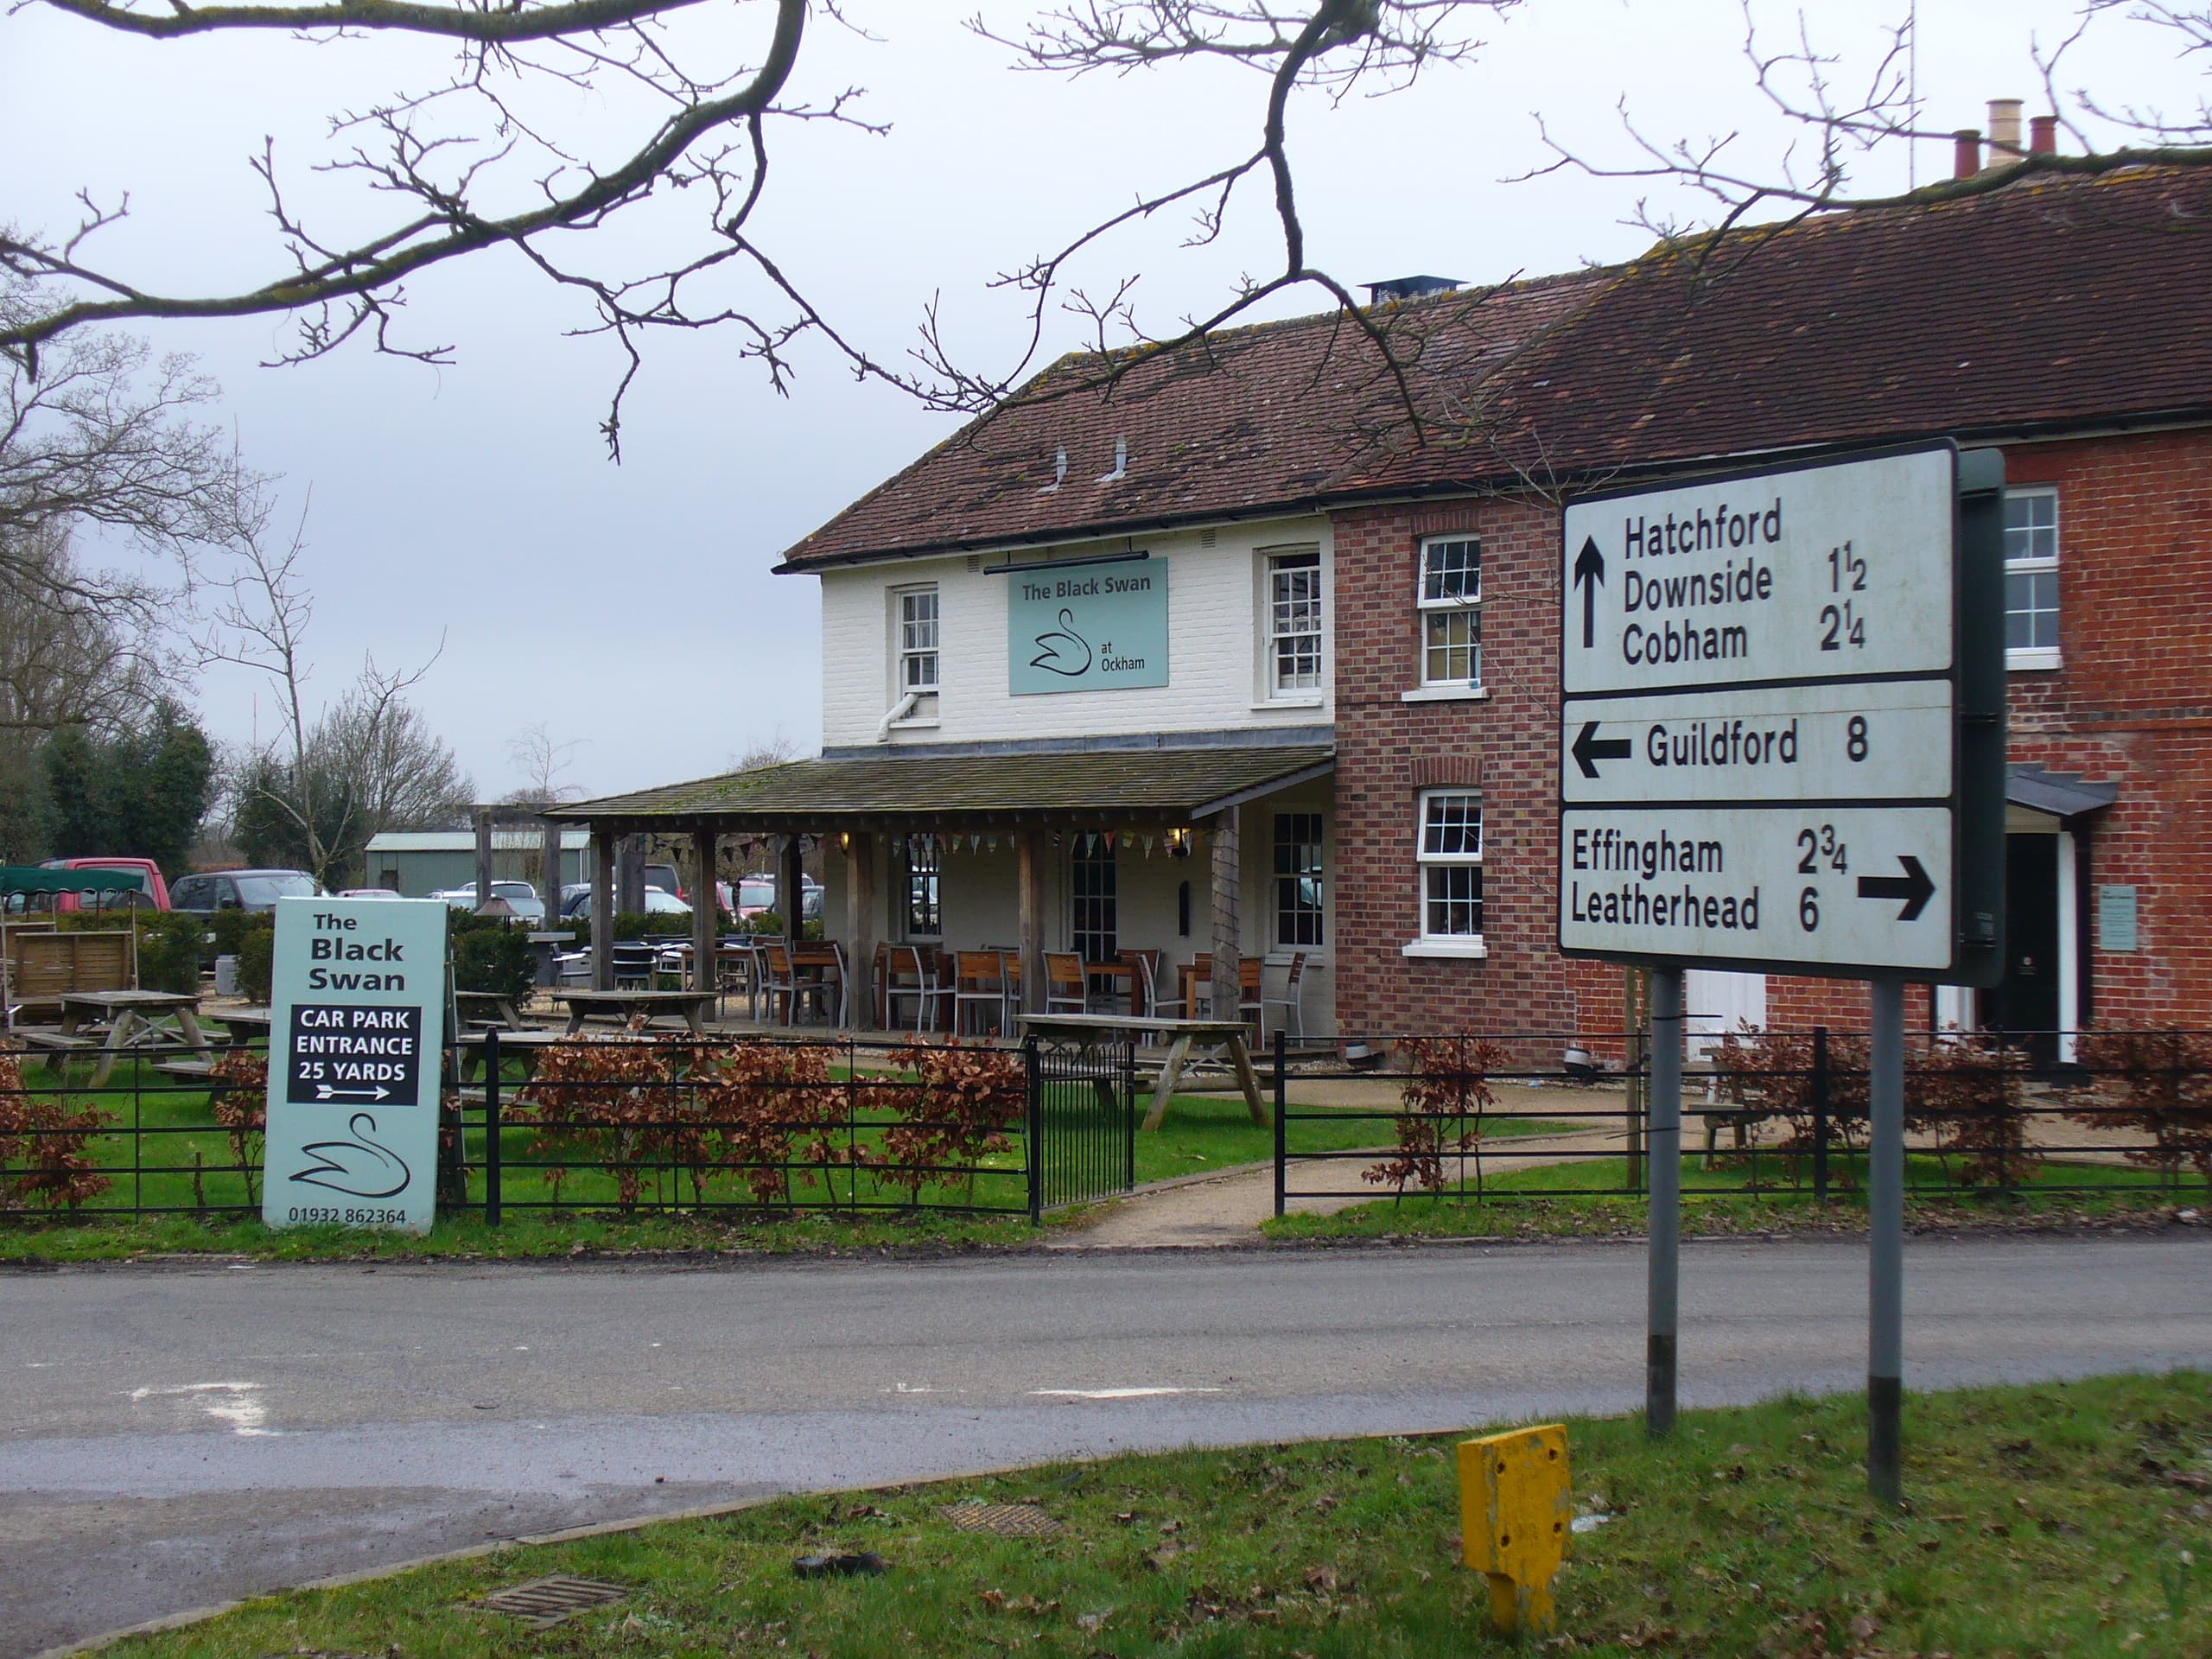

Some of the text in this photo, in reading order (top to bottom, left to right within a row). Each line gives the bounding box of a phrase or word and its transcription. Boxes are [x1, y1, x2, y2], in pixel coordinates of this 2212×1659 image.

[1624, 497, 1782, 560] Hatchford
[1022, 575, 1151, 601] The Black Swan
[1624, 557, 1773, 613] Downside
[1101, 641, 1113, 655] at
[1623, 619, 1748, 665] Cobham
[1101, 656, 1146, 672] Ockham
[1647, 715, 1869, 767] Guildford 8
[1573, 828, 1723, 880] Effingham
[1571, 881, 1820, 932] Leatherhead 6
[313, 913, 358, 931] The
[311, 938, 404, 962] Black
[308, 967, 405, 992] Swan
[300, 1009, 410, 1029] CAR PARK
[296, 1035, 413, 1056] ENTRANCE
[299, 1061, 406, 1082] 25 YARDS
[289, 1207, 407, 1224] 01932 862364
